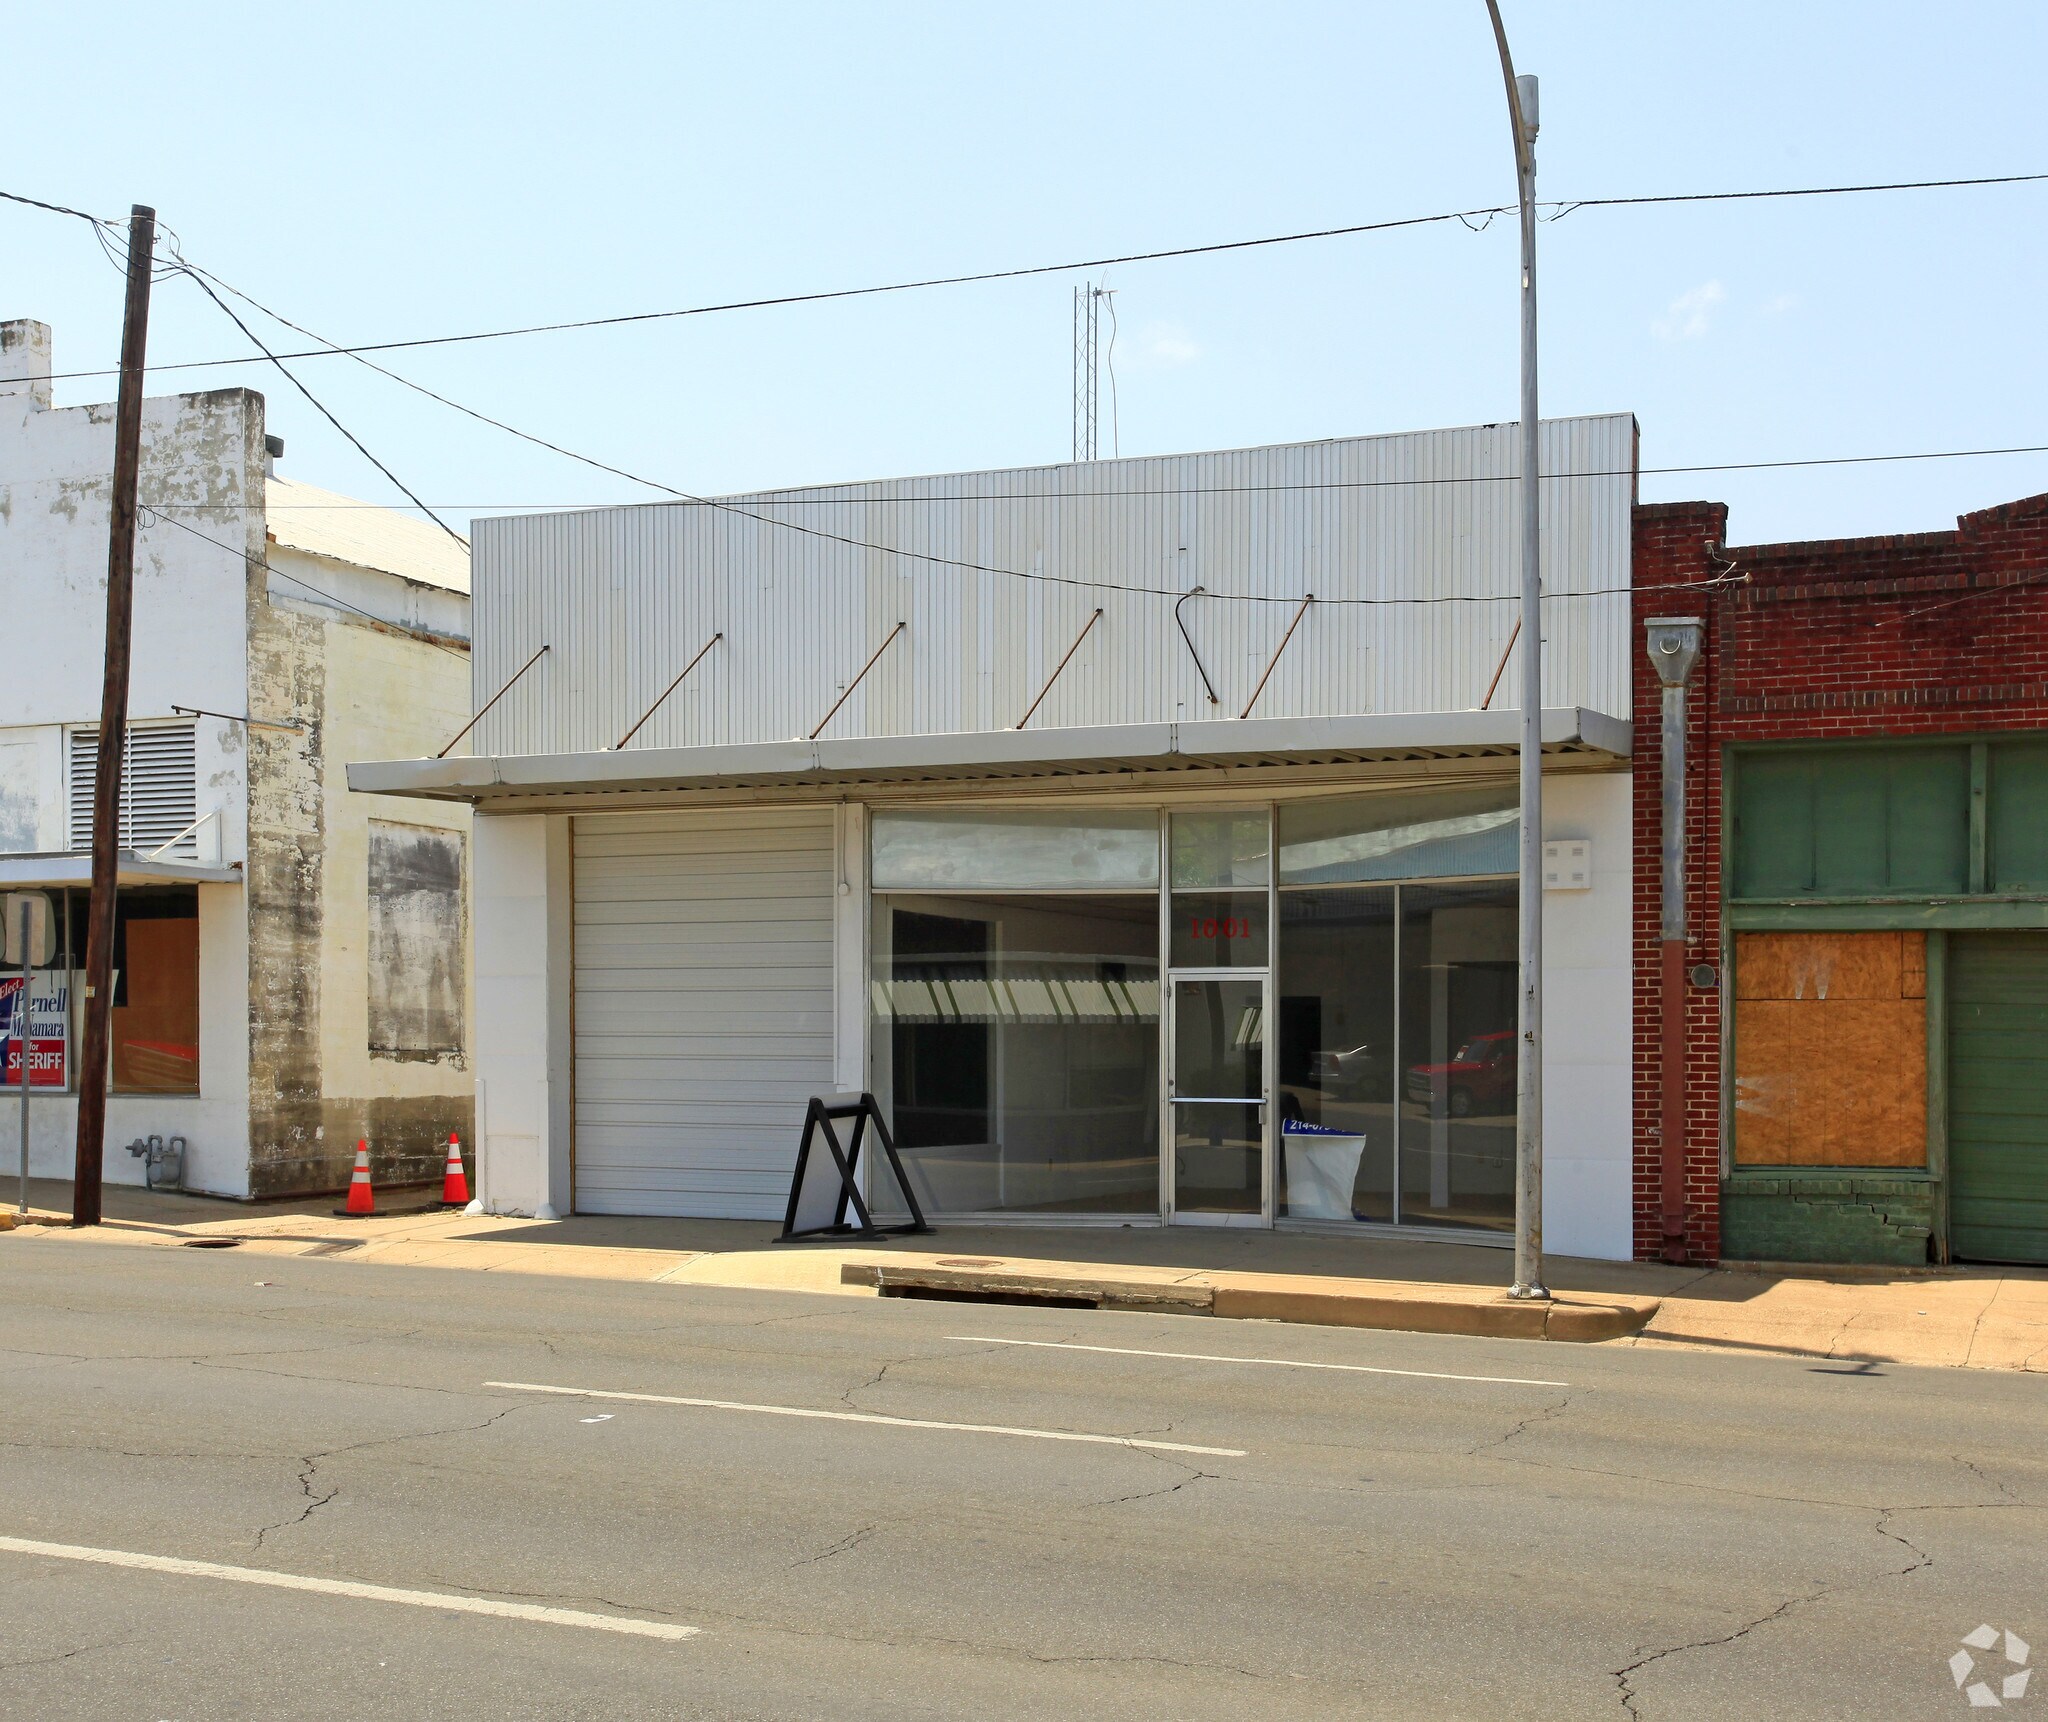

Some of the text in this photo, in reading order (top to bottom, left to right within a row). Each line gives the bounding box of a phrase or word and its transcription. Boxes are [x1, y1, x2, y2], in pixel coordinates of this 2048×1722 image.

[1191, 917, 1250, 939] 1001
[0, 980, 20, 999] Elect
[13, 988, 67, 1012] Prnell
[29, 1042, 39, 1051] for
